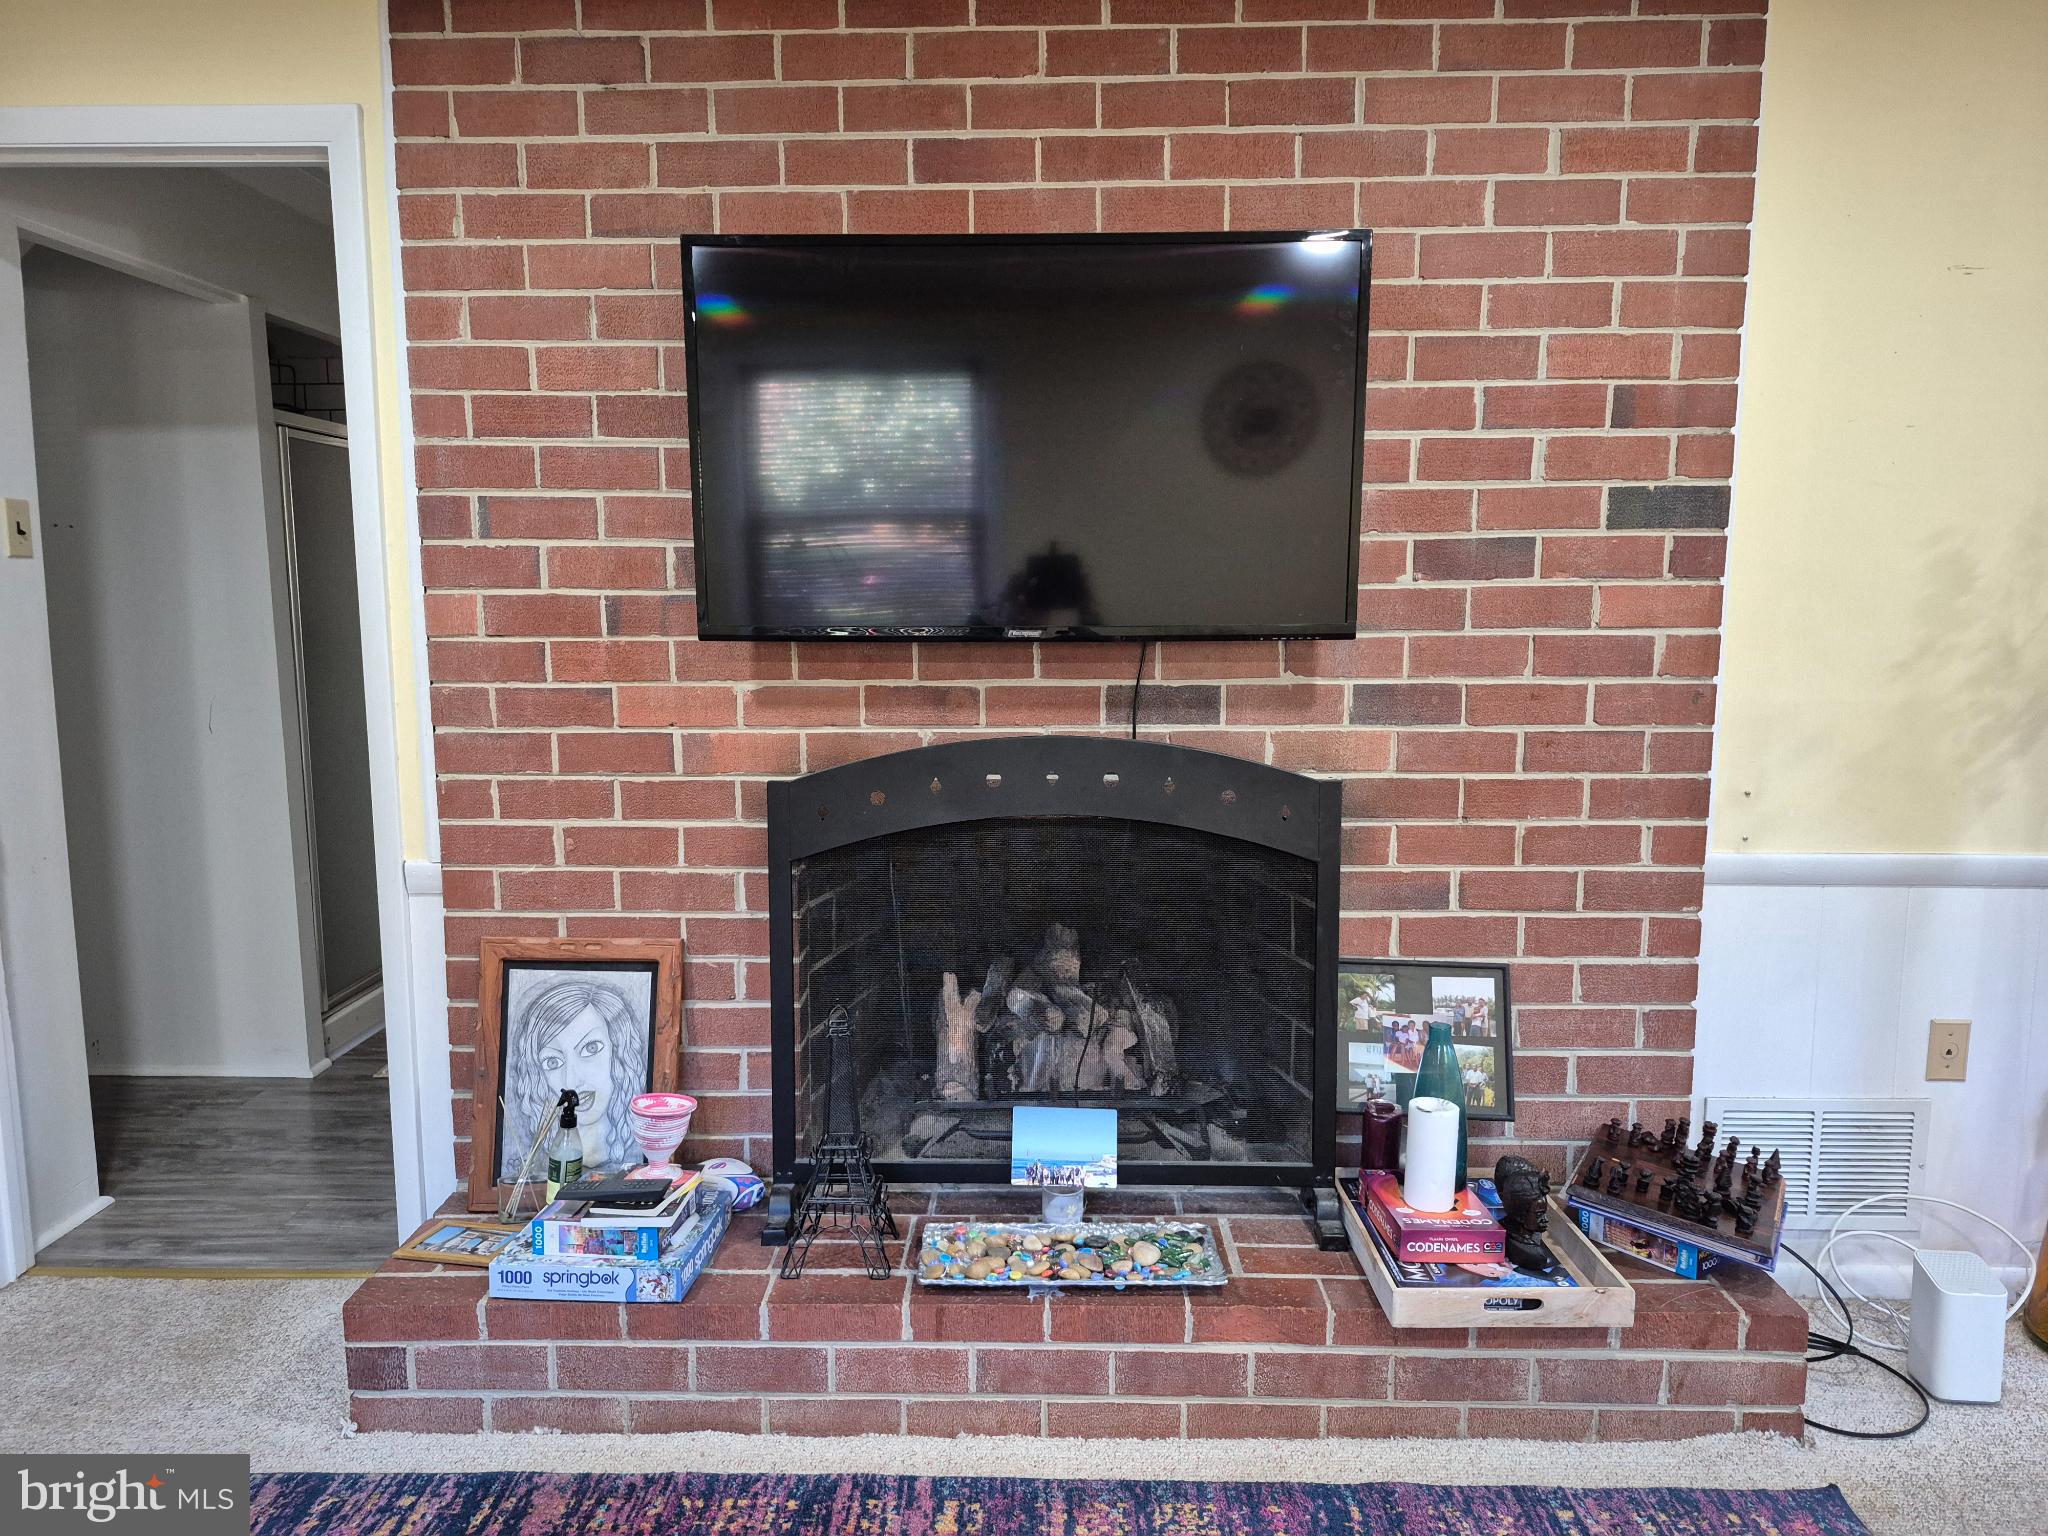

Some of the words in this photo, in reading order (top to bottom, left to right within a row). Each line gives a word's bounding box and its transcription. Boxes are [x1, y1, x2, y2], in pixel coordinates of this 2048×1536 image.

[1401, 1217, 1492, 1225] CODENAMES
[1581, 1210, 1589, 1232] 1000
[535, 1226, 543, 1249] 1000
[1406, 1241, 1480, 1254] CODENAMES
[1702, 1257, 1718, 1271] 1000
[497, 1270, 533, 1285] 1000
[542, 1269, 620, 1288] springbok
